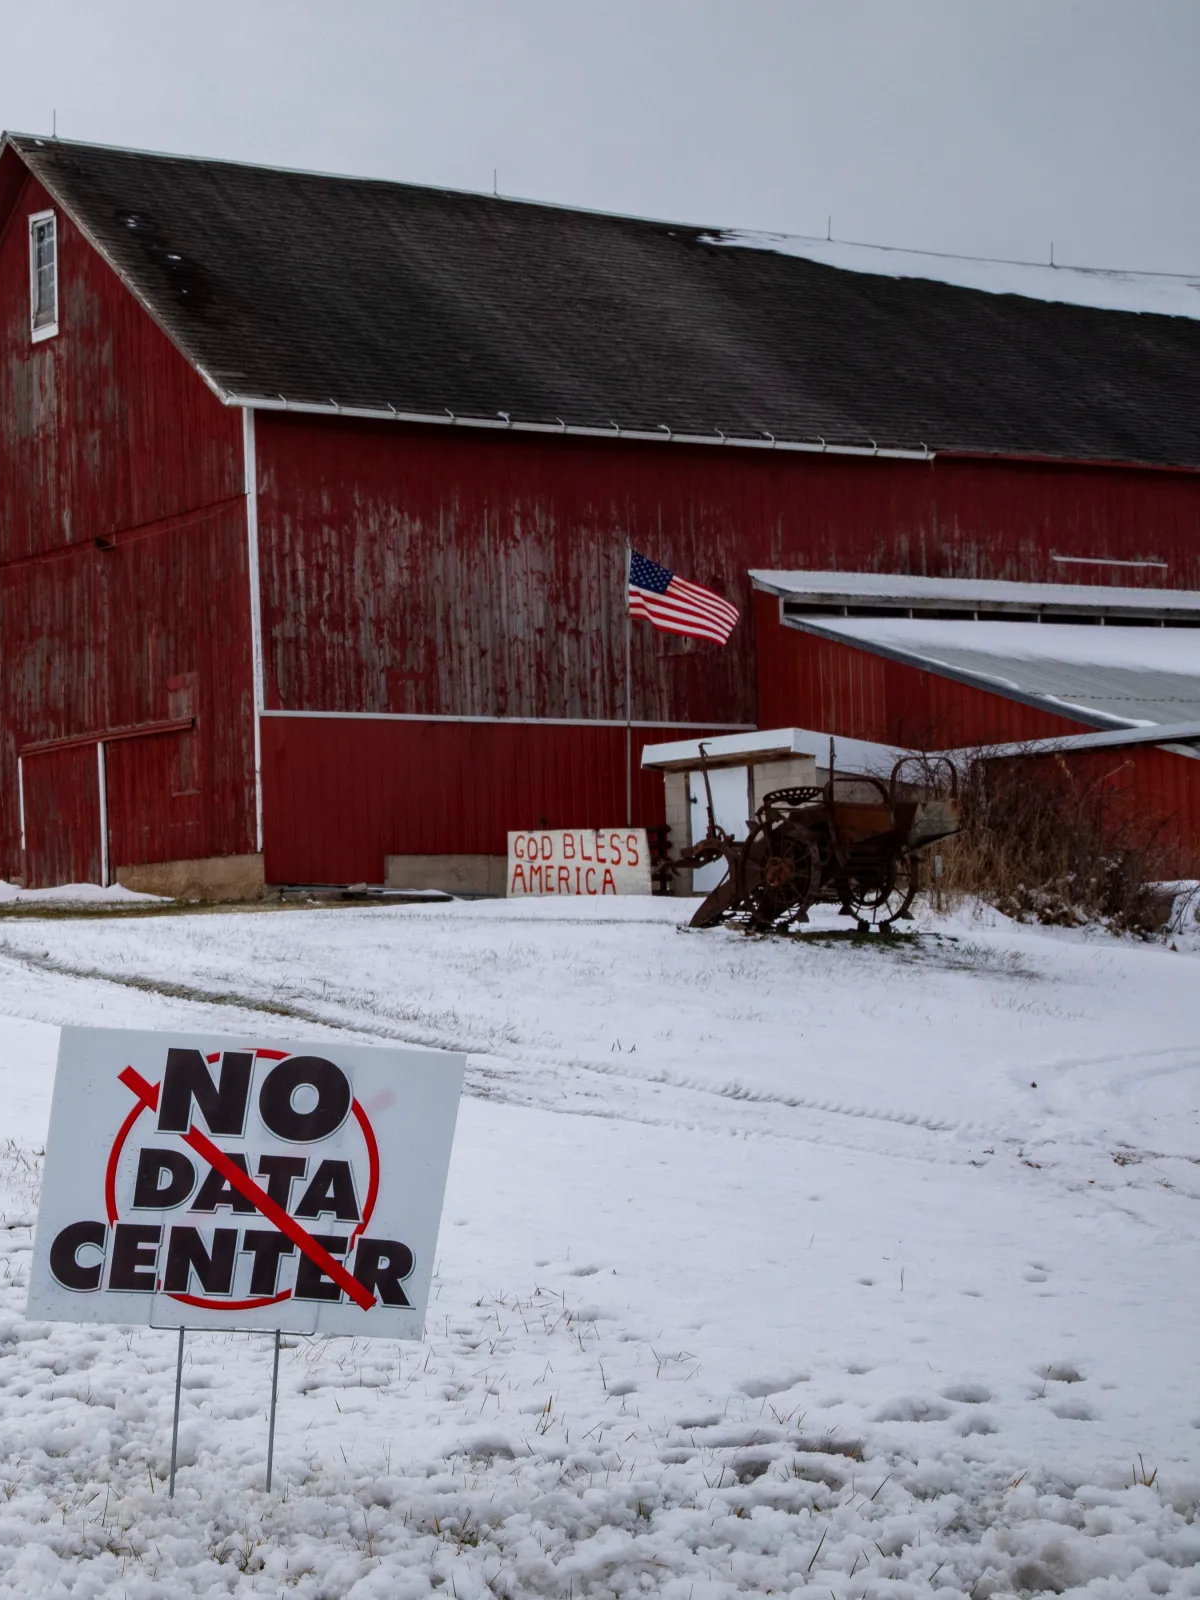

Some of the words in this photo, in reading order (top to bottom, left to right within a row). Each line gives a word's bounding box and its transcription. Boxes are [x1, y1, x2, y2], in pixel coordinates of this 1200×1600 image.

[511, 864, 617, 895] AMERICA
[514, 835, 553, 861] GOD
[563, 833, 639, 866] BLESS
[155, 1047, 354, 1144] NO
[131, 1147, 364, 1223] DATA
[49, 1220, 416, 1309] CENTER
